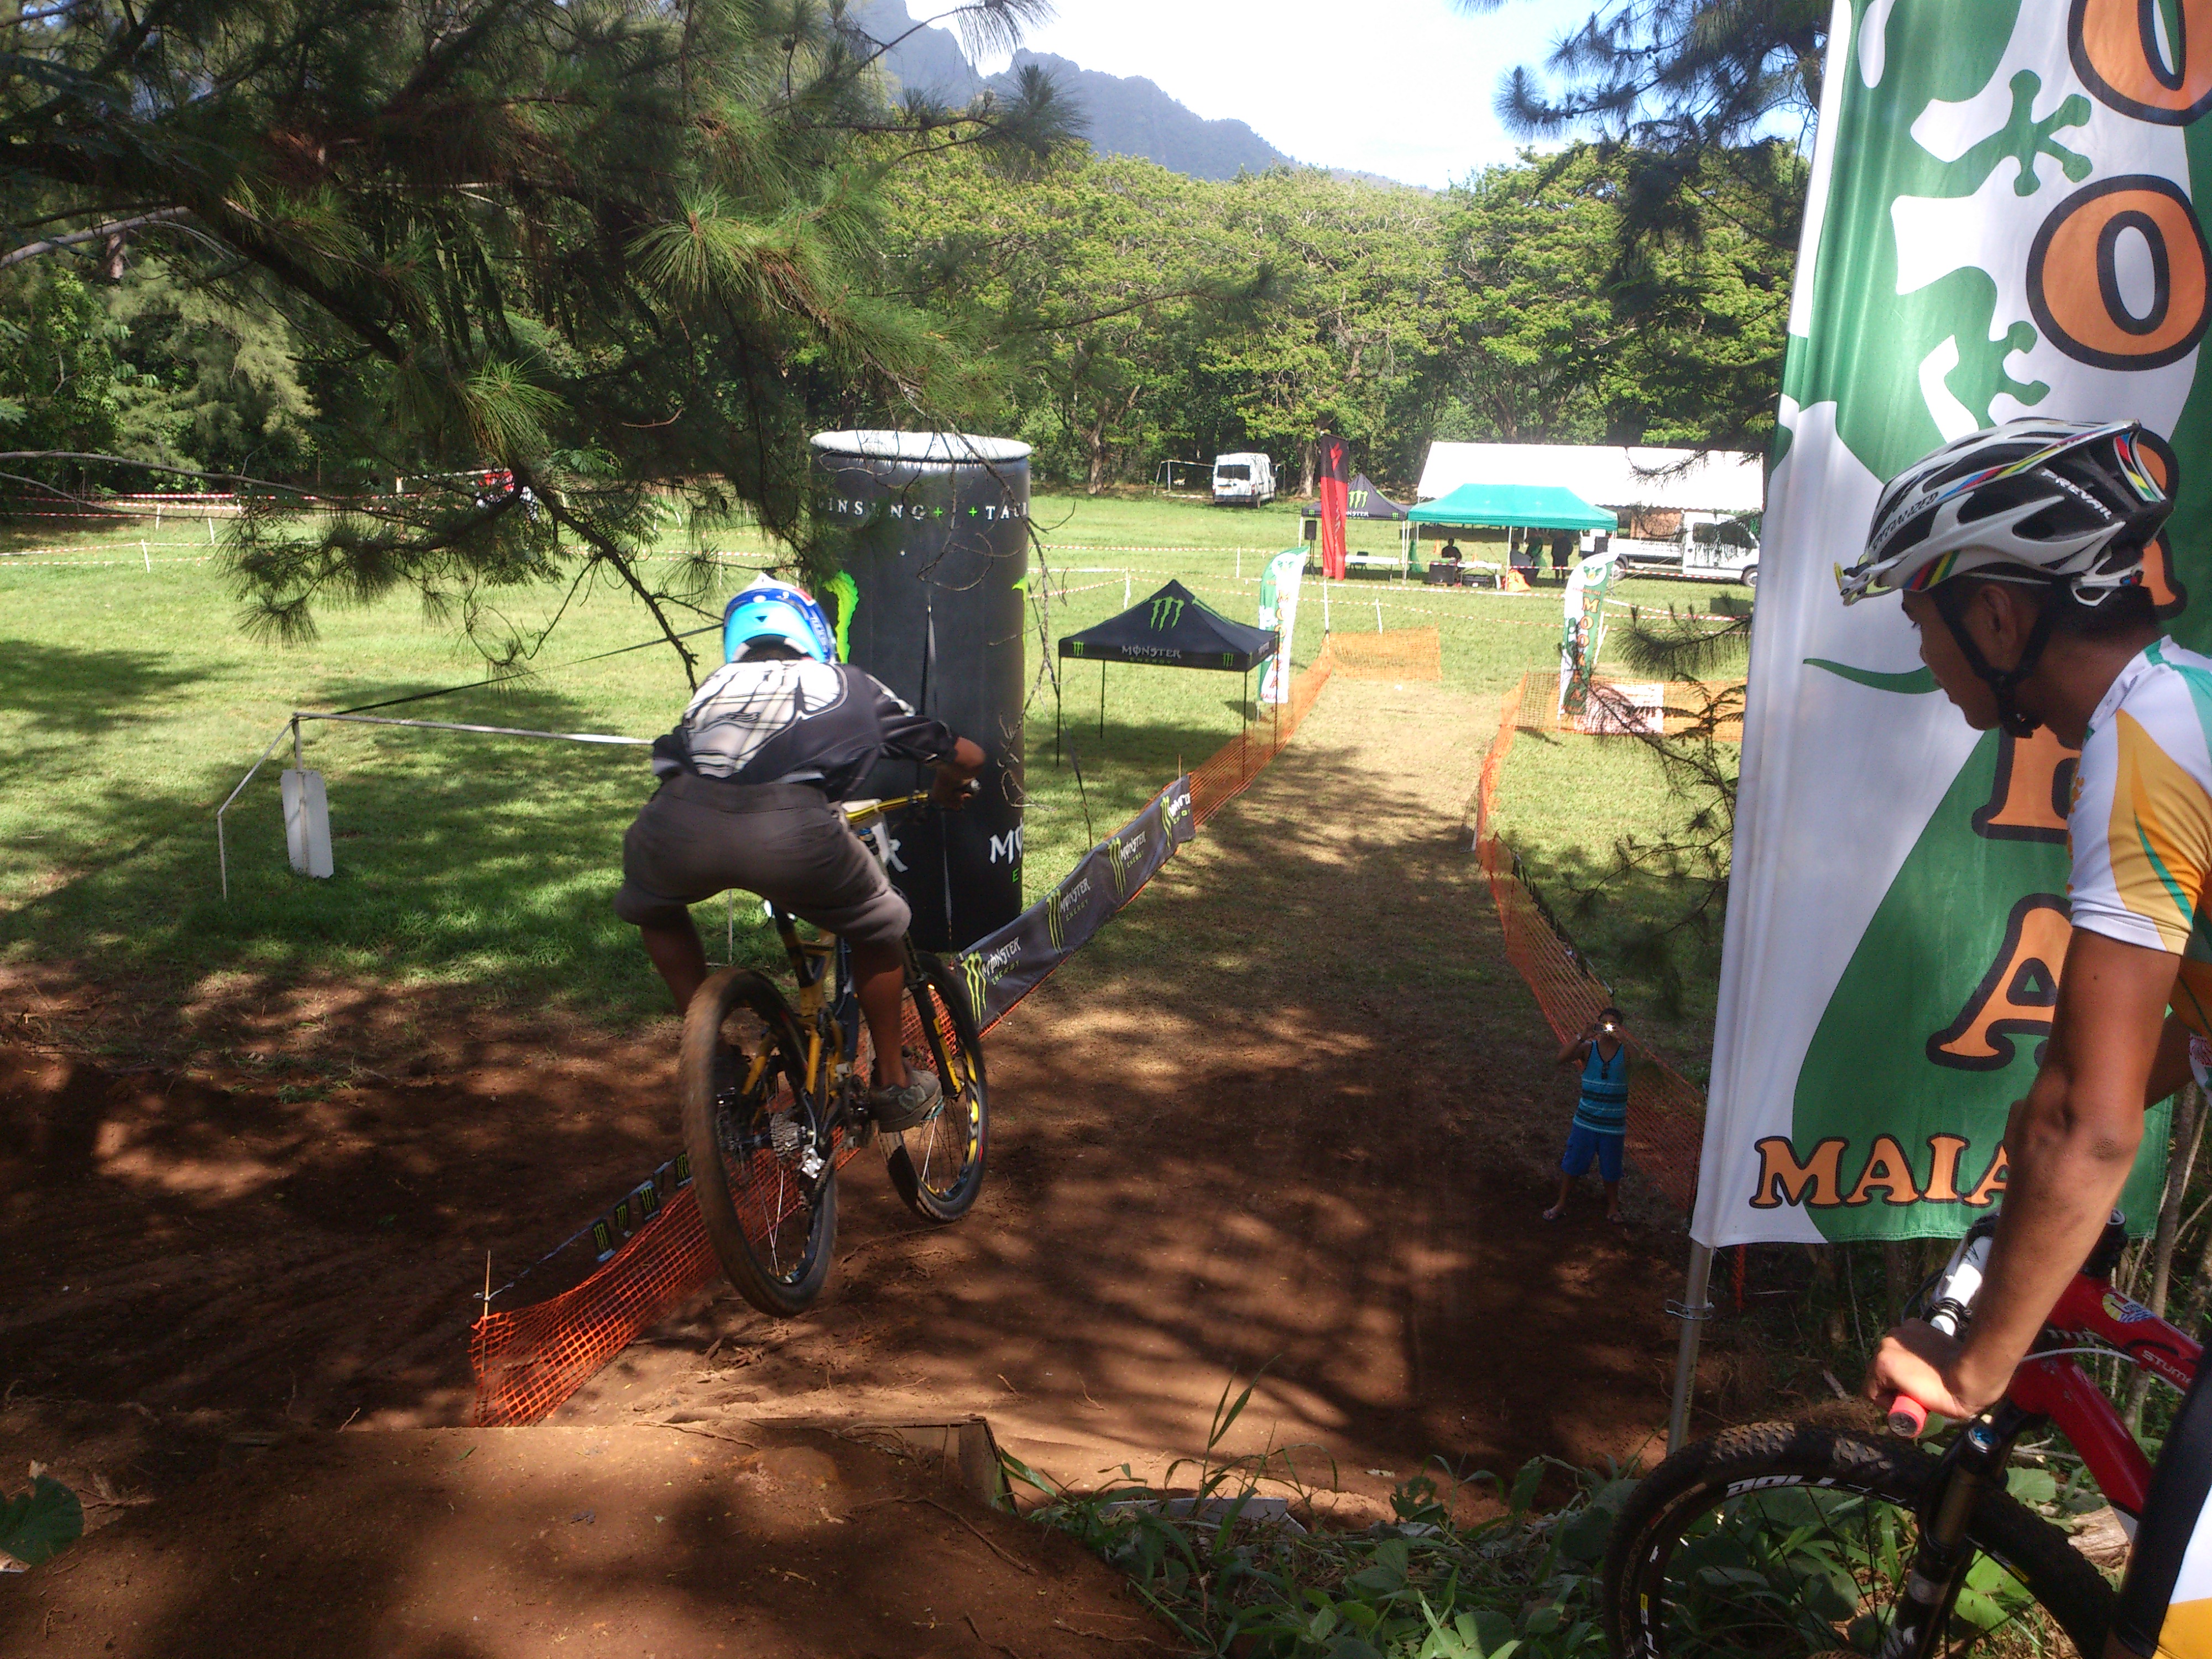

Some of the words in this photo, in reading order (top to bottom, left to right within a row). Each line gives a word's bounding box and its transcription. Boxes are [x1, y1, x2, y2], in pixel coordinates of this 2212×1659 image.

[2041, 469, 2112, 520] PREVAIL
[1121, 644, 1182, 659] MONSTER
[982, 937, 1021, 978] MONSTER
